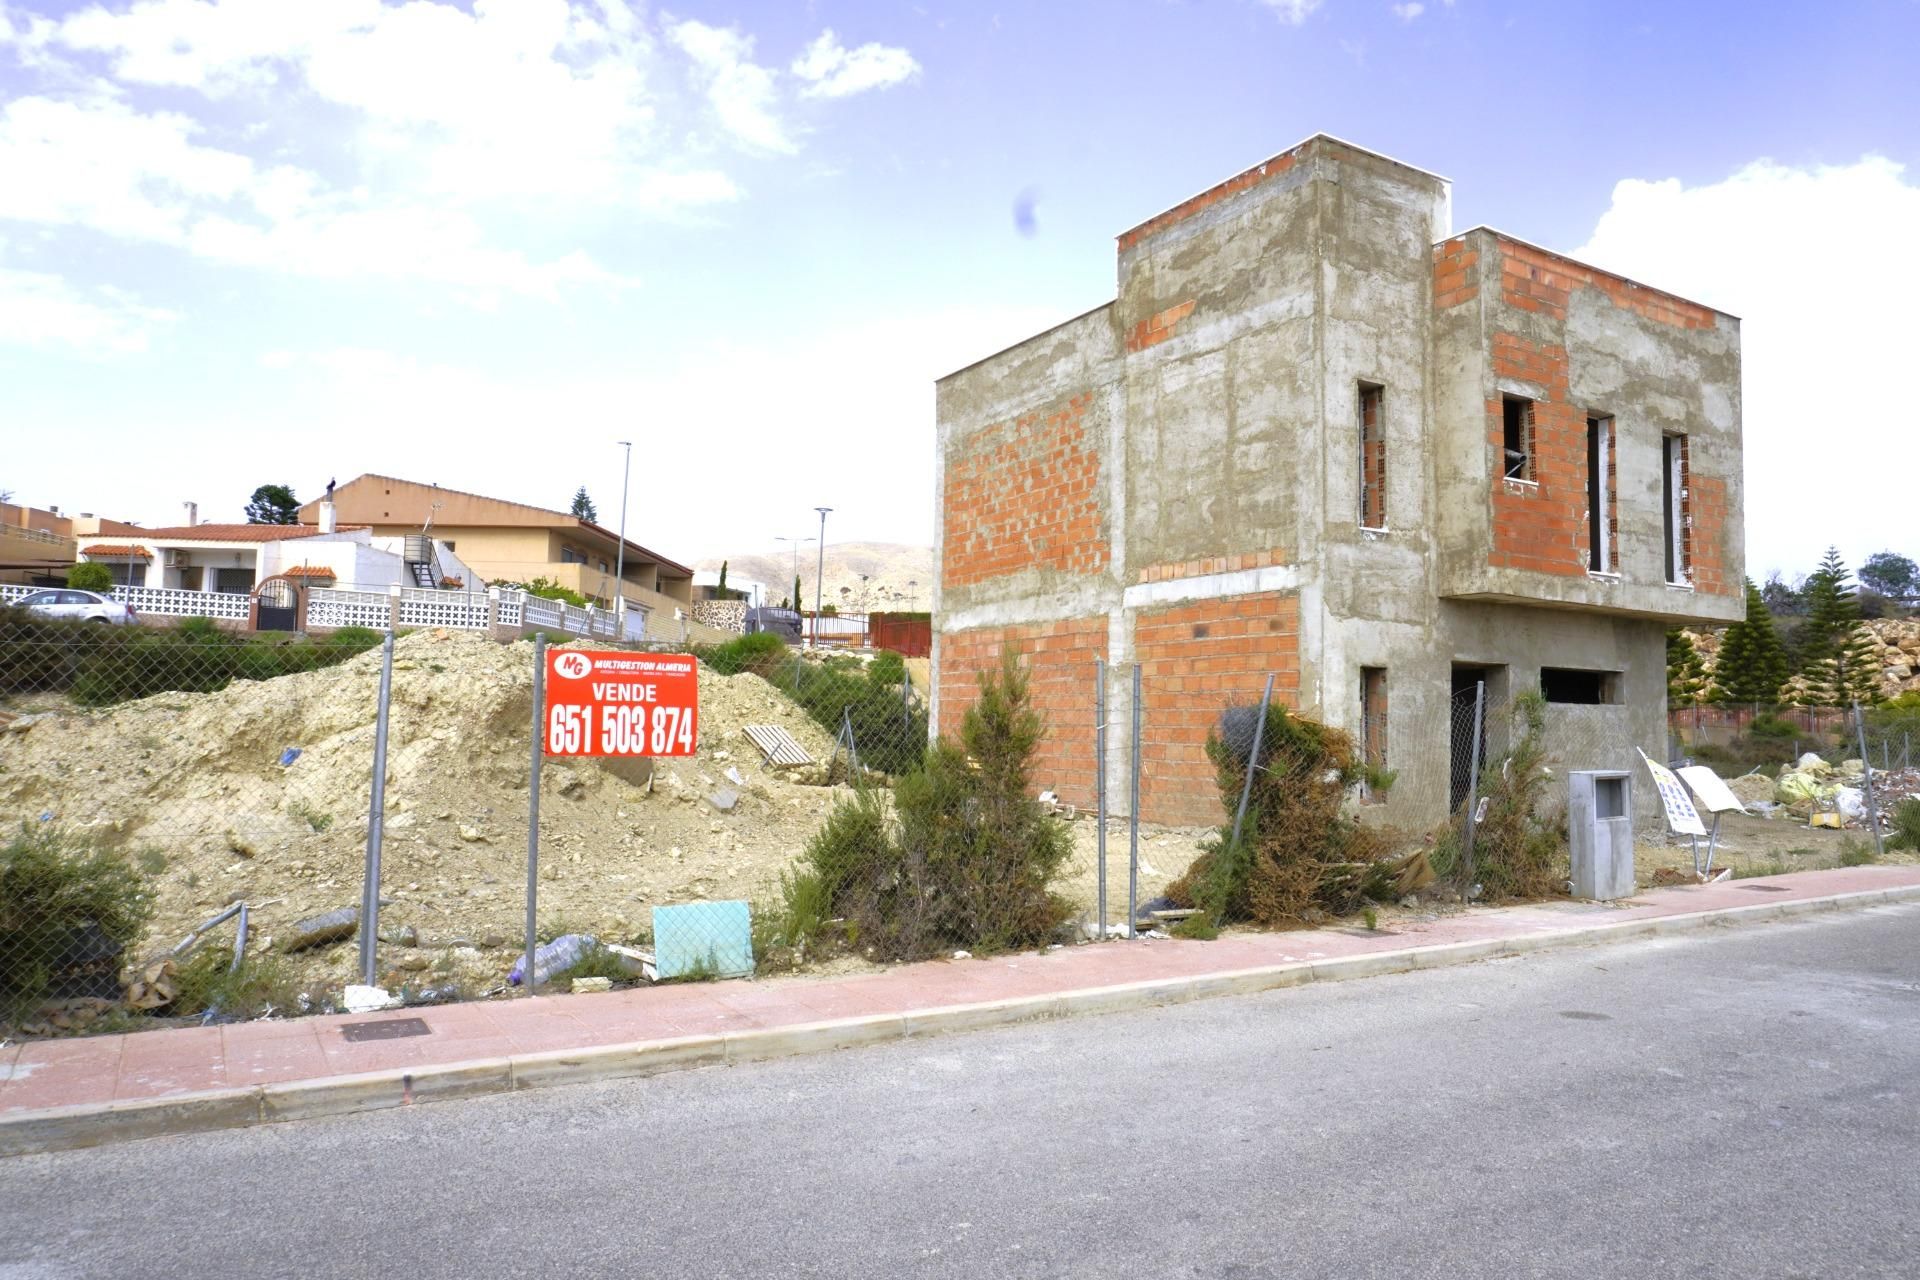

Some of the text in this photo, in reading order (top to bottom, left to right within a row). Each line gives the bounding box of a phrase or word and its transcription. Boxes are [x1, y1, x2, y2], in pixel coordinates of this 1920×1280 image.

[563, 656, 583, 676] MG
[594, 660, 691, 672] MULTIGESTION ALMERIA
[592, 683, 656, 702] VENDE
[550, 704, 692, 753] 651 503 874
